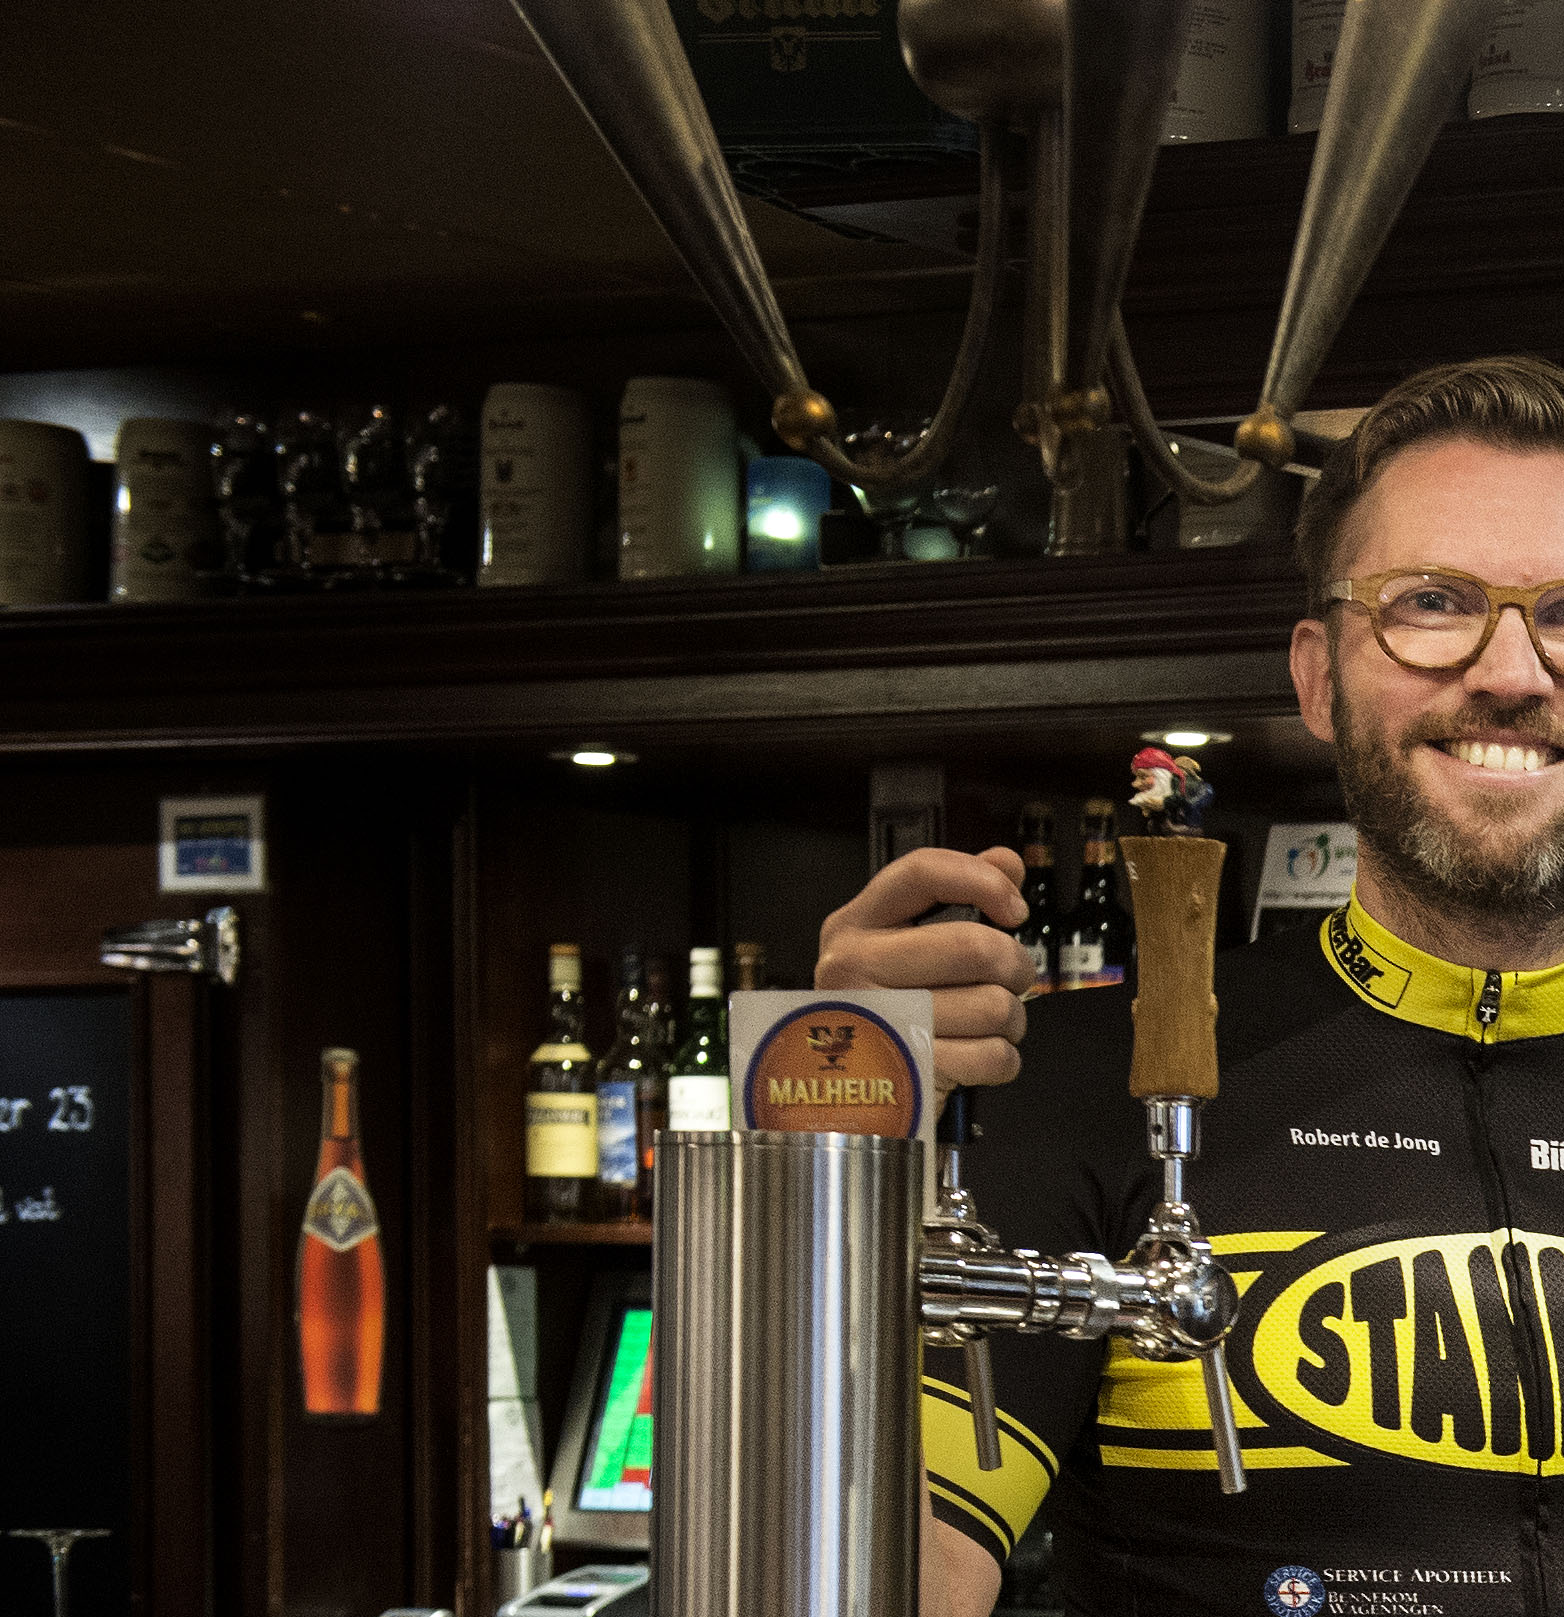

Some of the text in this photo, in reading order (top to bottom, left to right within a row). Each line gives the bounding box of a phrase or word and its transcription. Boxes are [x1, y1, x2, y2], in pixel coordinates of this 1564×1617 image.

[768, 1076, 897, 1105] MALHEUR
[48, 1085, 94, 1132] 23
[1290, 1128, 1441, 1155] Robert de Jong
[1323, 1568, 1513, 1584] SERVICE APOTHEEK
